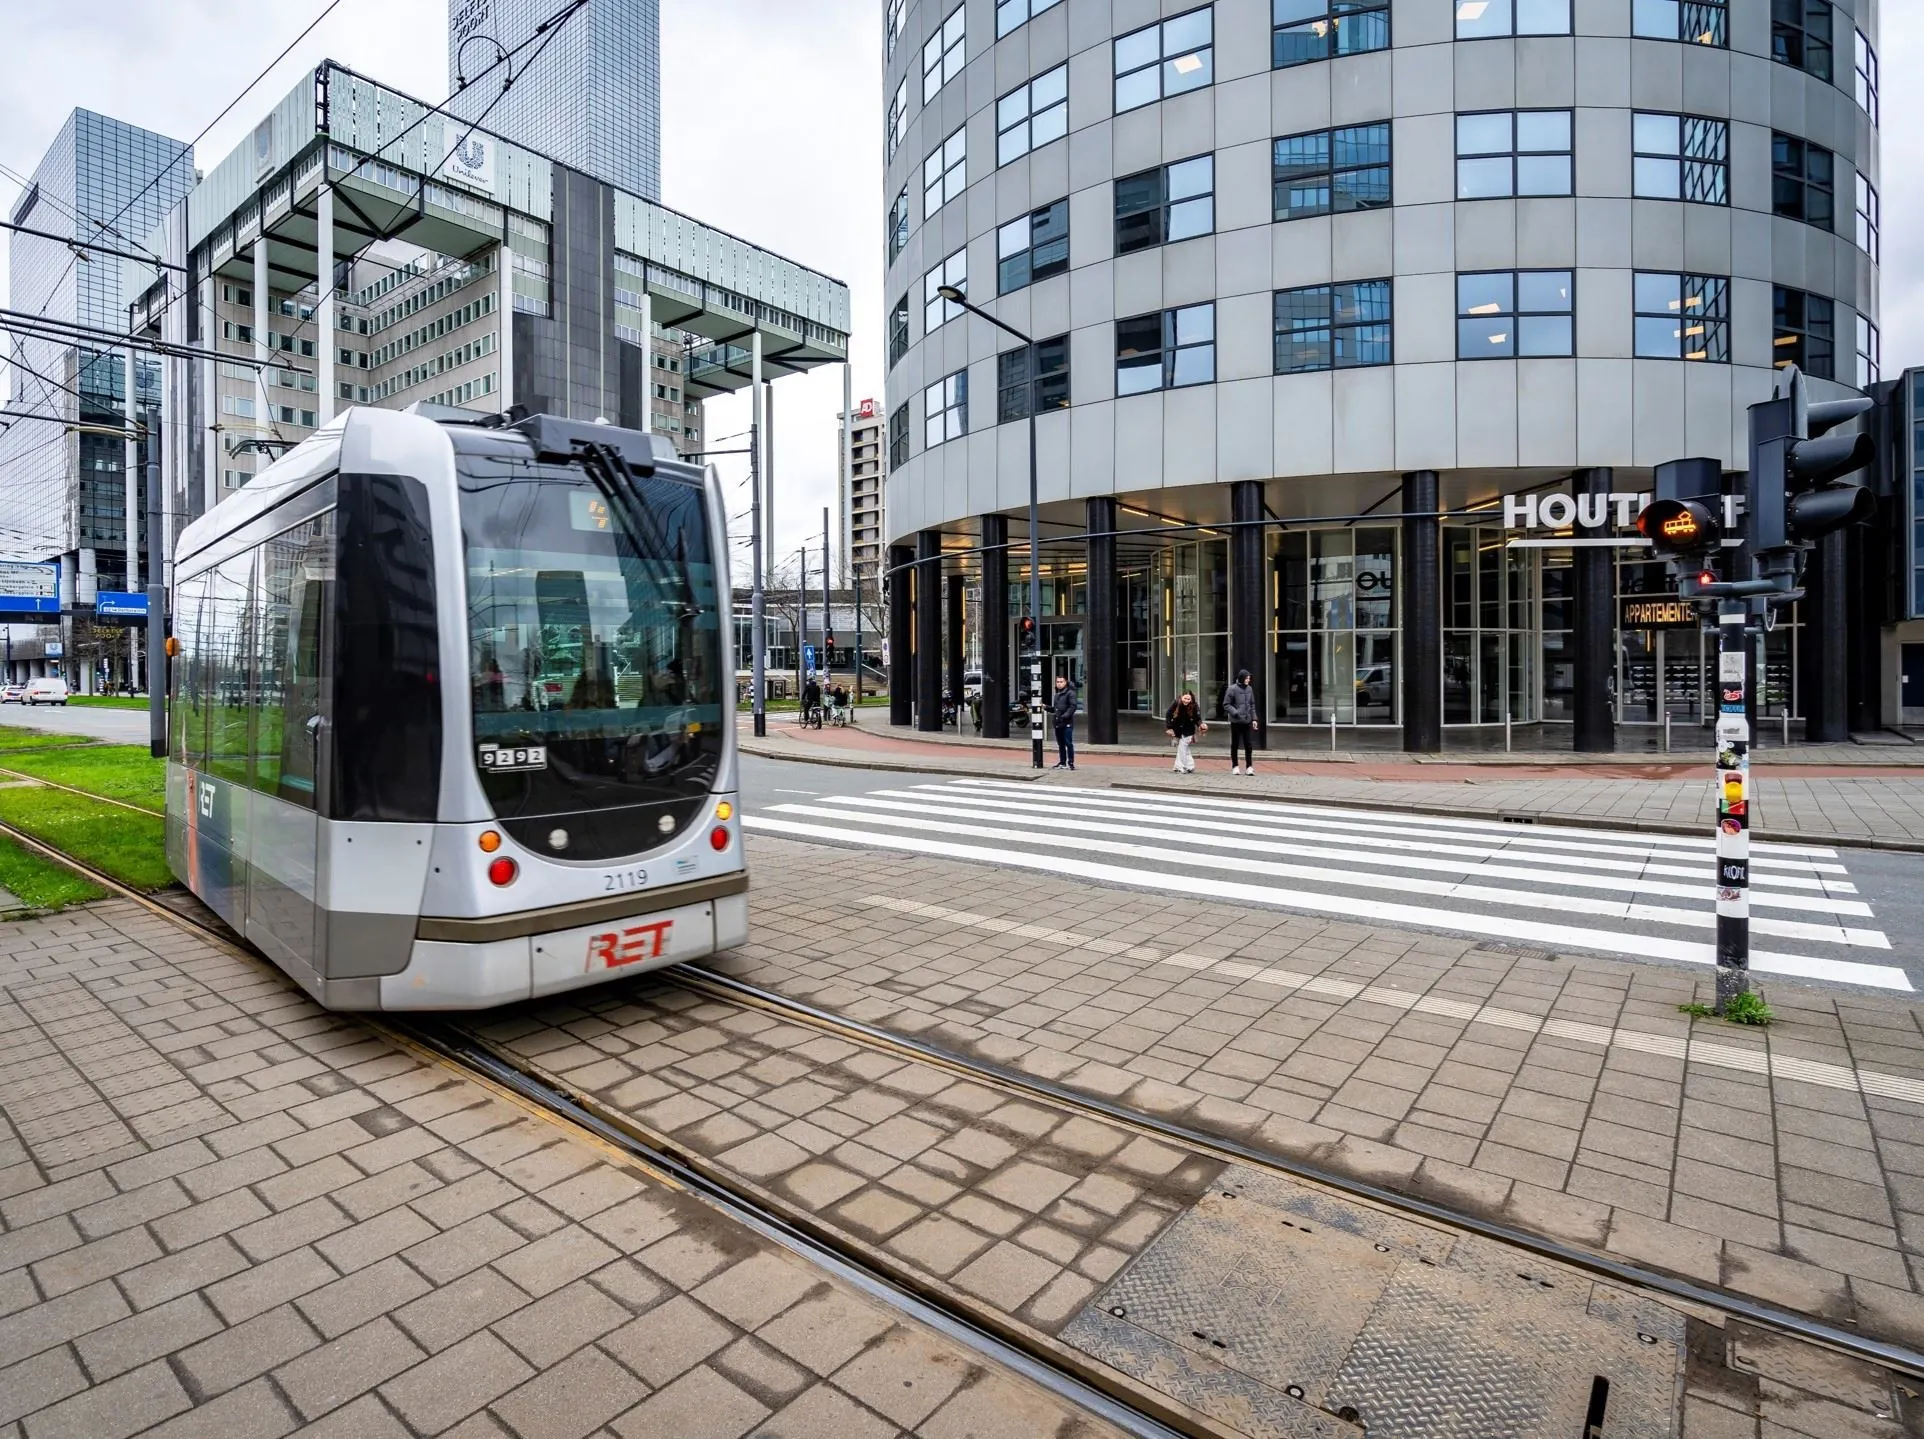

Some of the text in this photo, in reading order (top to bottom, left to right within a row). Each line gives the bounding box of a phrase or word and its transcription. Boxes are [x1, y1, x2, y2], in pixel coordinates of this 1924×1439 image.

[452, 164, 489, 184] Unilever
[1503, 493, 1746, 529] HOUTF
[483, 750, 541, 765] 9292
[603, 869, 649, 891] 2119
[584, 919, 675, 974] RET
